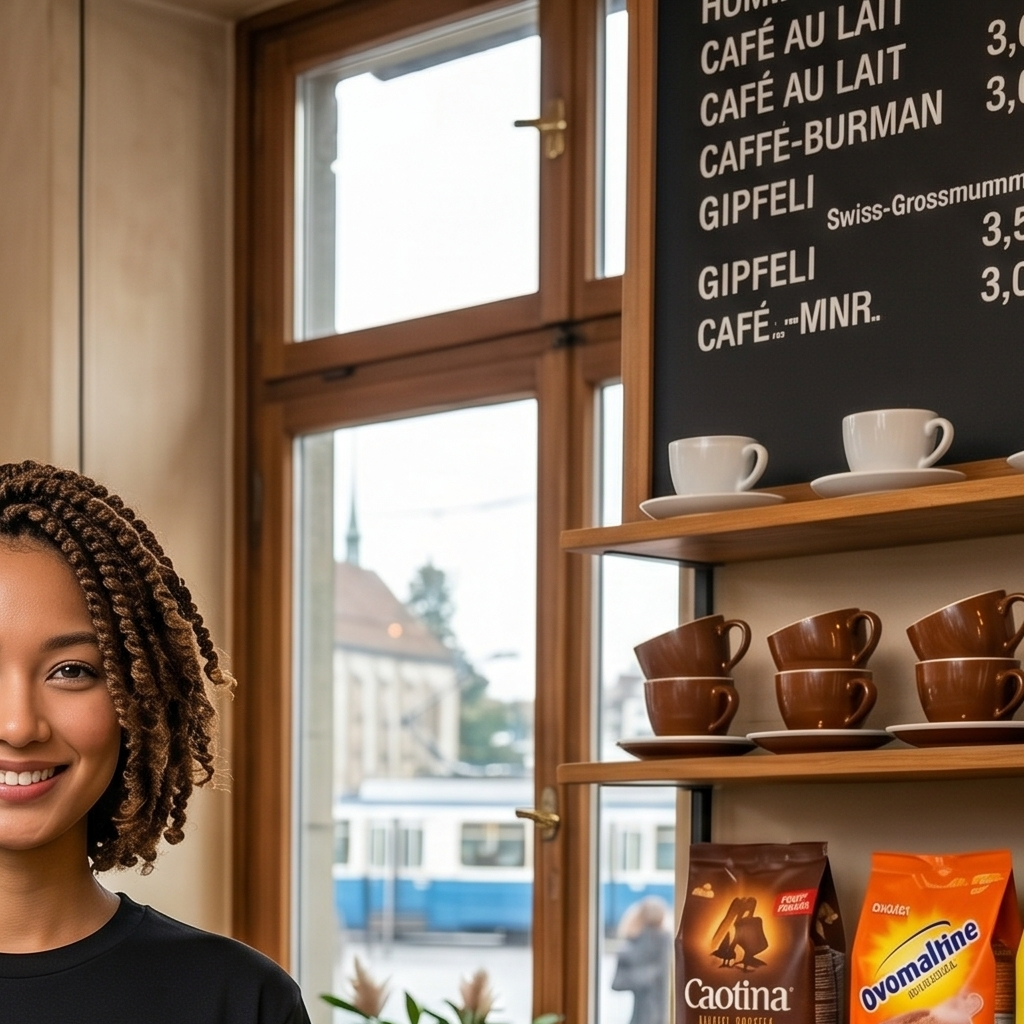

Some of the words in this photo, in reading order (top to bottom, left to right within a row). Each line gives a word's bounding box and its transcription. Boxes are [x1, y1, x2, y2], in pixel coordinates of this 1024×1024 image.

[700, 17, 775, 75] CAFÉ
[784, 11, 825, 54] AU
[701, 70, 773, 126] CAFÉ
[783, 65, 824, 107] AU
[837, 43, 907, 94] LAIT
[700, 175, 813, 230] GIPFELI
[699, 246, 814, 300] GIPFELI
